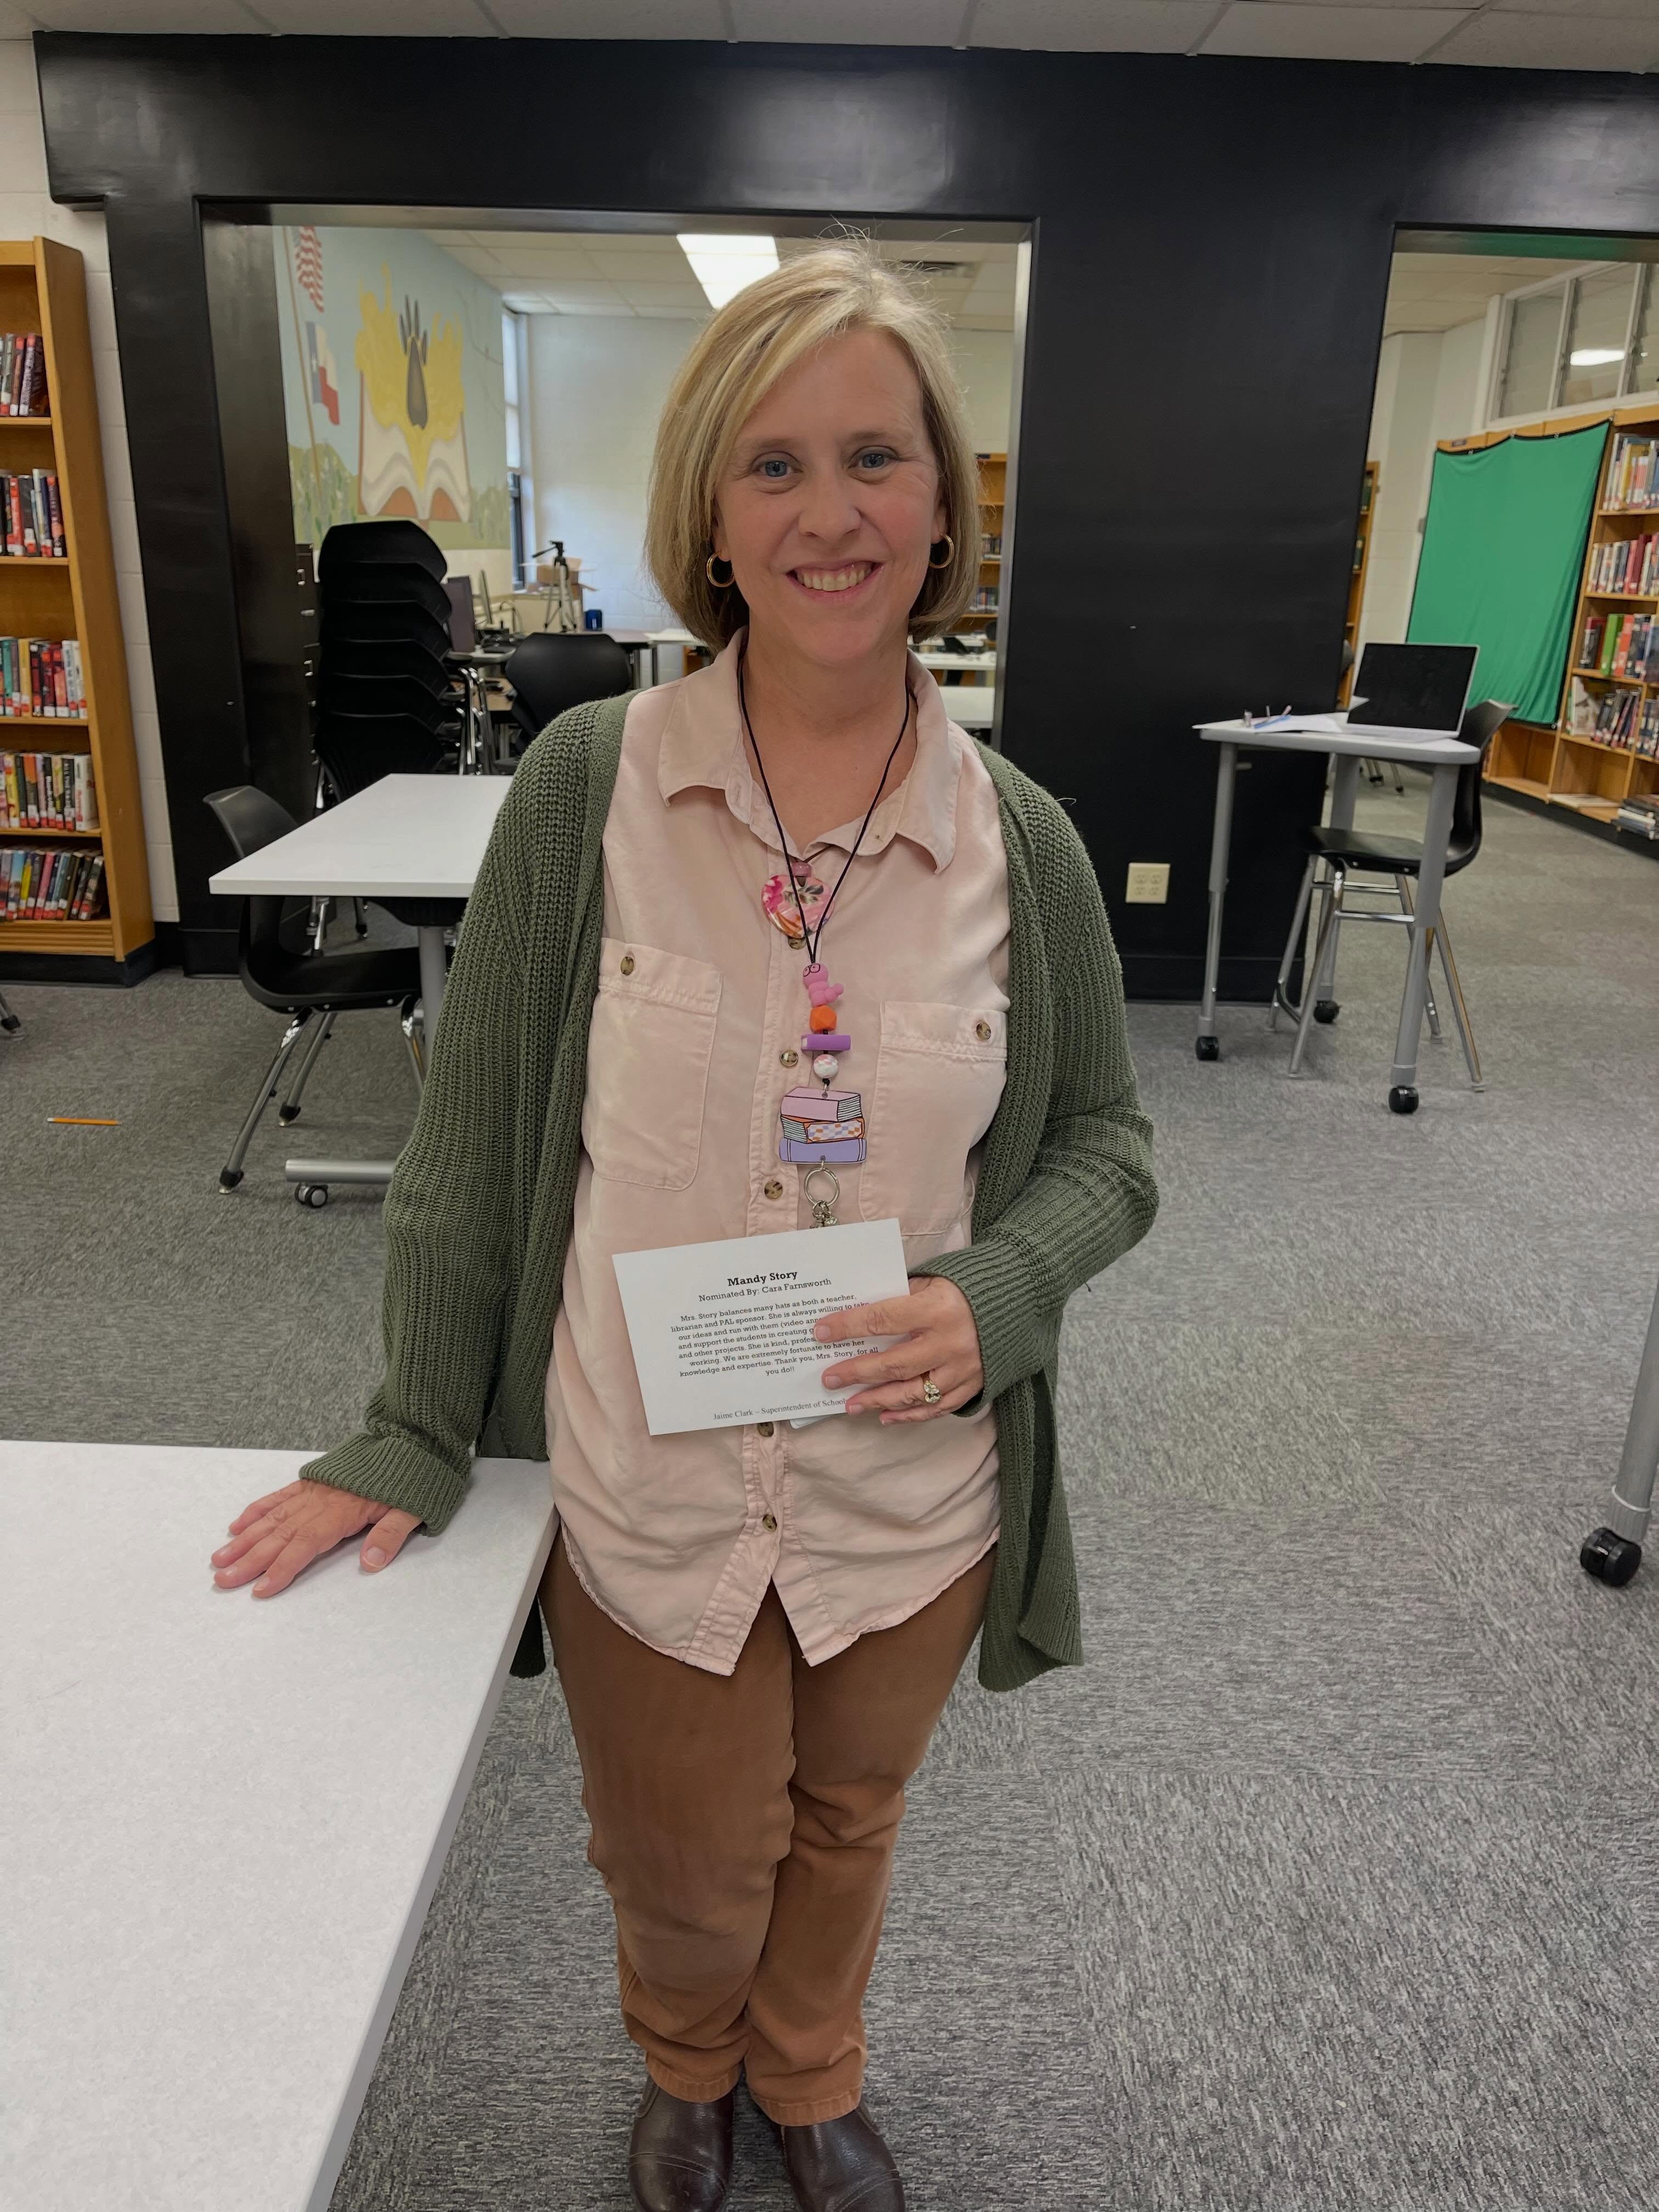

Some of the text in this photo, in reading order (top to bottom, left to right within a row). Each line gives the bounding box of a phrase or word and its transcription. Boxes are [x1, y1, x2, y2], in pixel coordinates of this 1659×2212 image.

[727, 1272, 798, 1286] Mandy Story
[698, 1290, 744, 1302] Nominated
[762, 1285, 782, 1293] Cara
[784, 1278, 832, 1290] Farnsworth
[719, 1308, 752, 1317] balances
[754, 1304, 774, 1312] many
[775, 1300, 790, 1309] hats
[671, 1322, 703, 1333] librarian
[704, 1319, 718, 1328] and
[792, 1308, 817, 1317] always
[818, 1304, 843, 1313] willing
[692, 1330, 712, 1339] ideas
[781, 1318, 804, 1329] (video
[693, 1339, 721, 1348] support
[736, 1333, 767, 1342] students
[777, 1328, 807, 1338] creating
[791, 1338, 817, 1346] profes
[751, 1348, 788, 1358] extremely
[790, 1345, 822, 1353] fortunate
[680, 1367, 720, 1377] knowledge
[713, 1412, 733, 1420] Jaime
[735, 1409, 753, 1418] Clark
[761, 1402, 812, 1414] Superintendent
[822, 1398, 846, 1407] School
